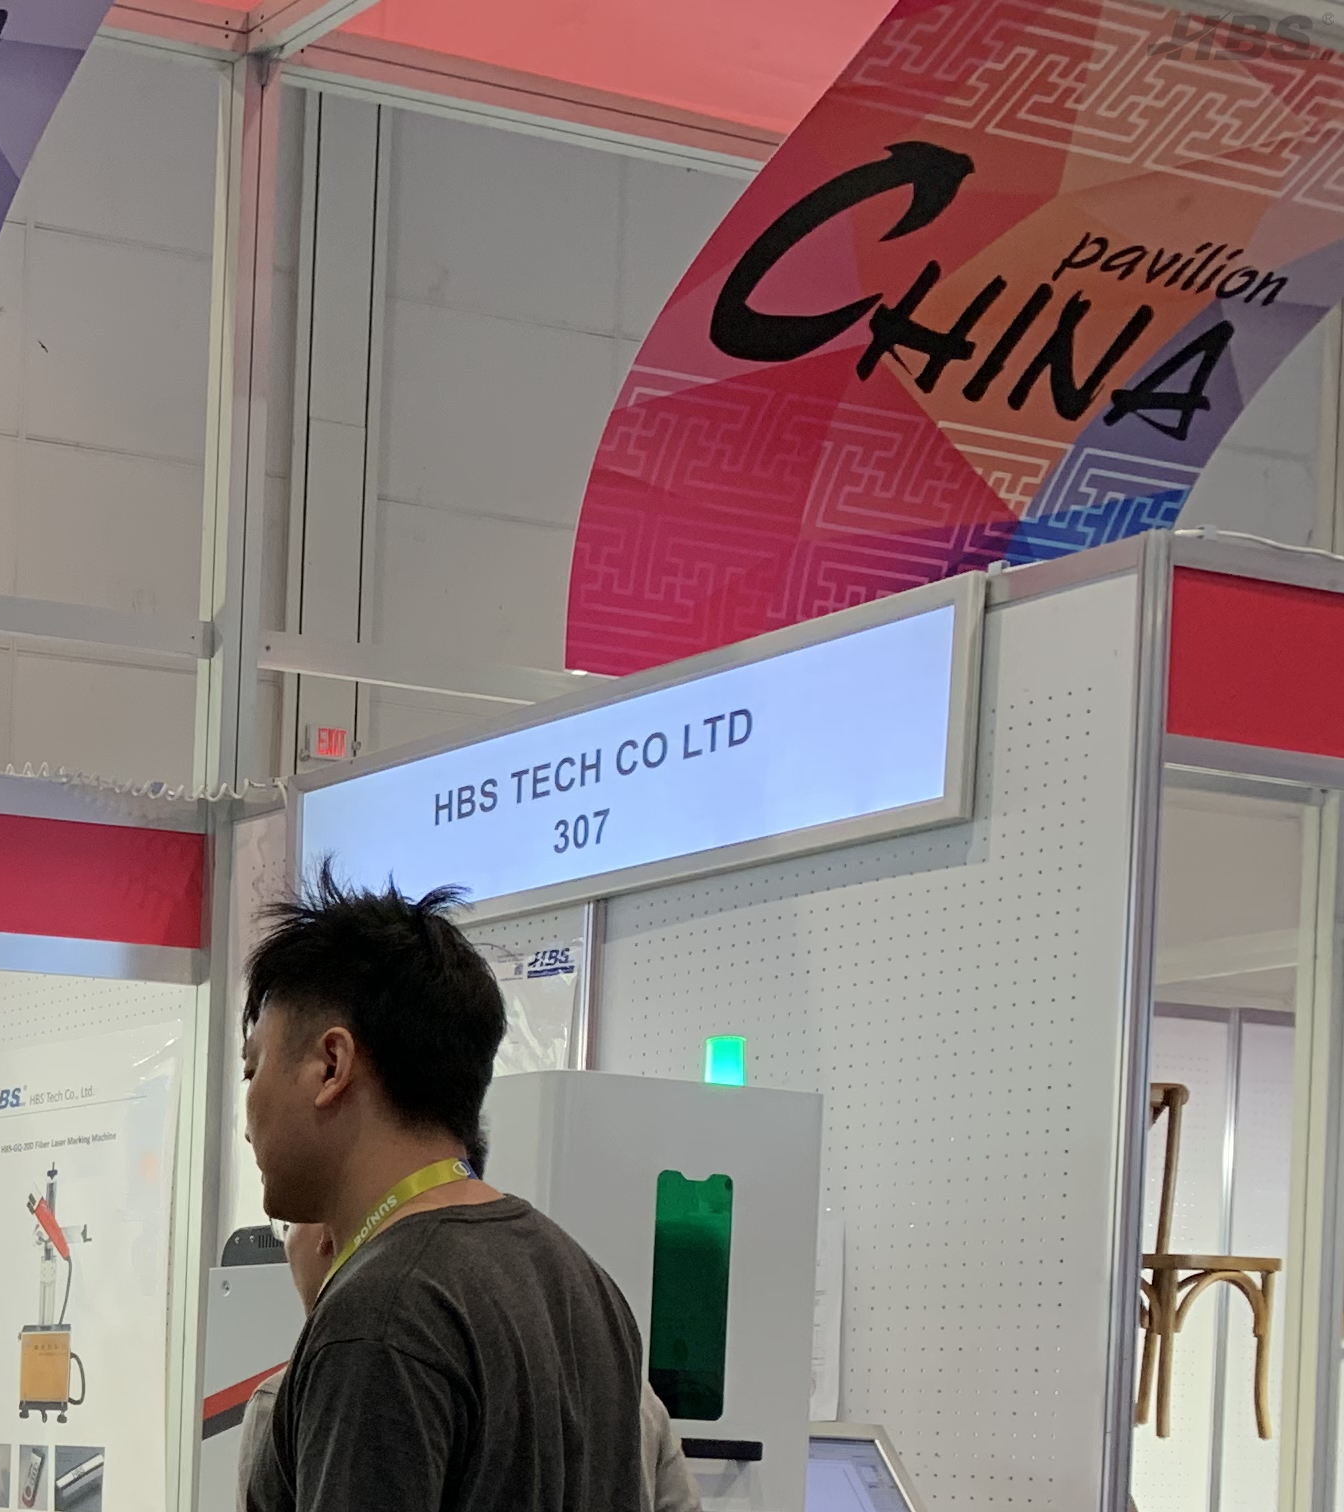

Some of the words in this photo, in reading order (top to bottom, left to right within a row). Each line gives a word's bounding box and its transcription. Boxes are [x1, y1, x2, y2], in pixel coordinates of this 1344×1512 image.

[710, 141, 1234, 440] CHINA
[1052, 232, 1288, 306] pavilion
[434, 778, 498, 826] HBS
[511, 749, 602, 805] TECH
[616, 732, 668, 776] CO
[683, 708, 753, 759] LTD
[553, 809, 610, 854] 307
[528, 948, 570, 967] HBS
[29, 1092, 45, 1106] HBS
[47, 1091, 63, 1104] Tech
[67, 1135, 90, 1146] Marking
[91, 1132, 117, 1142] Machine
